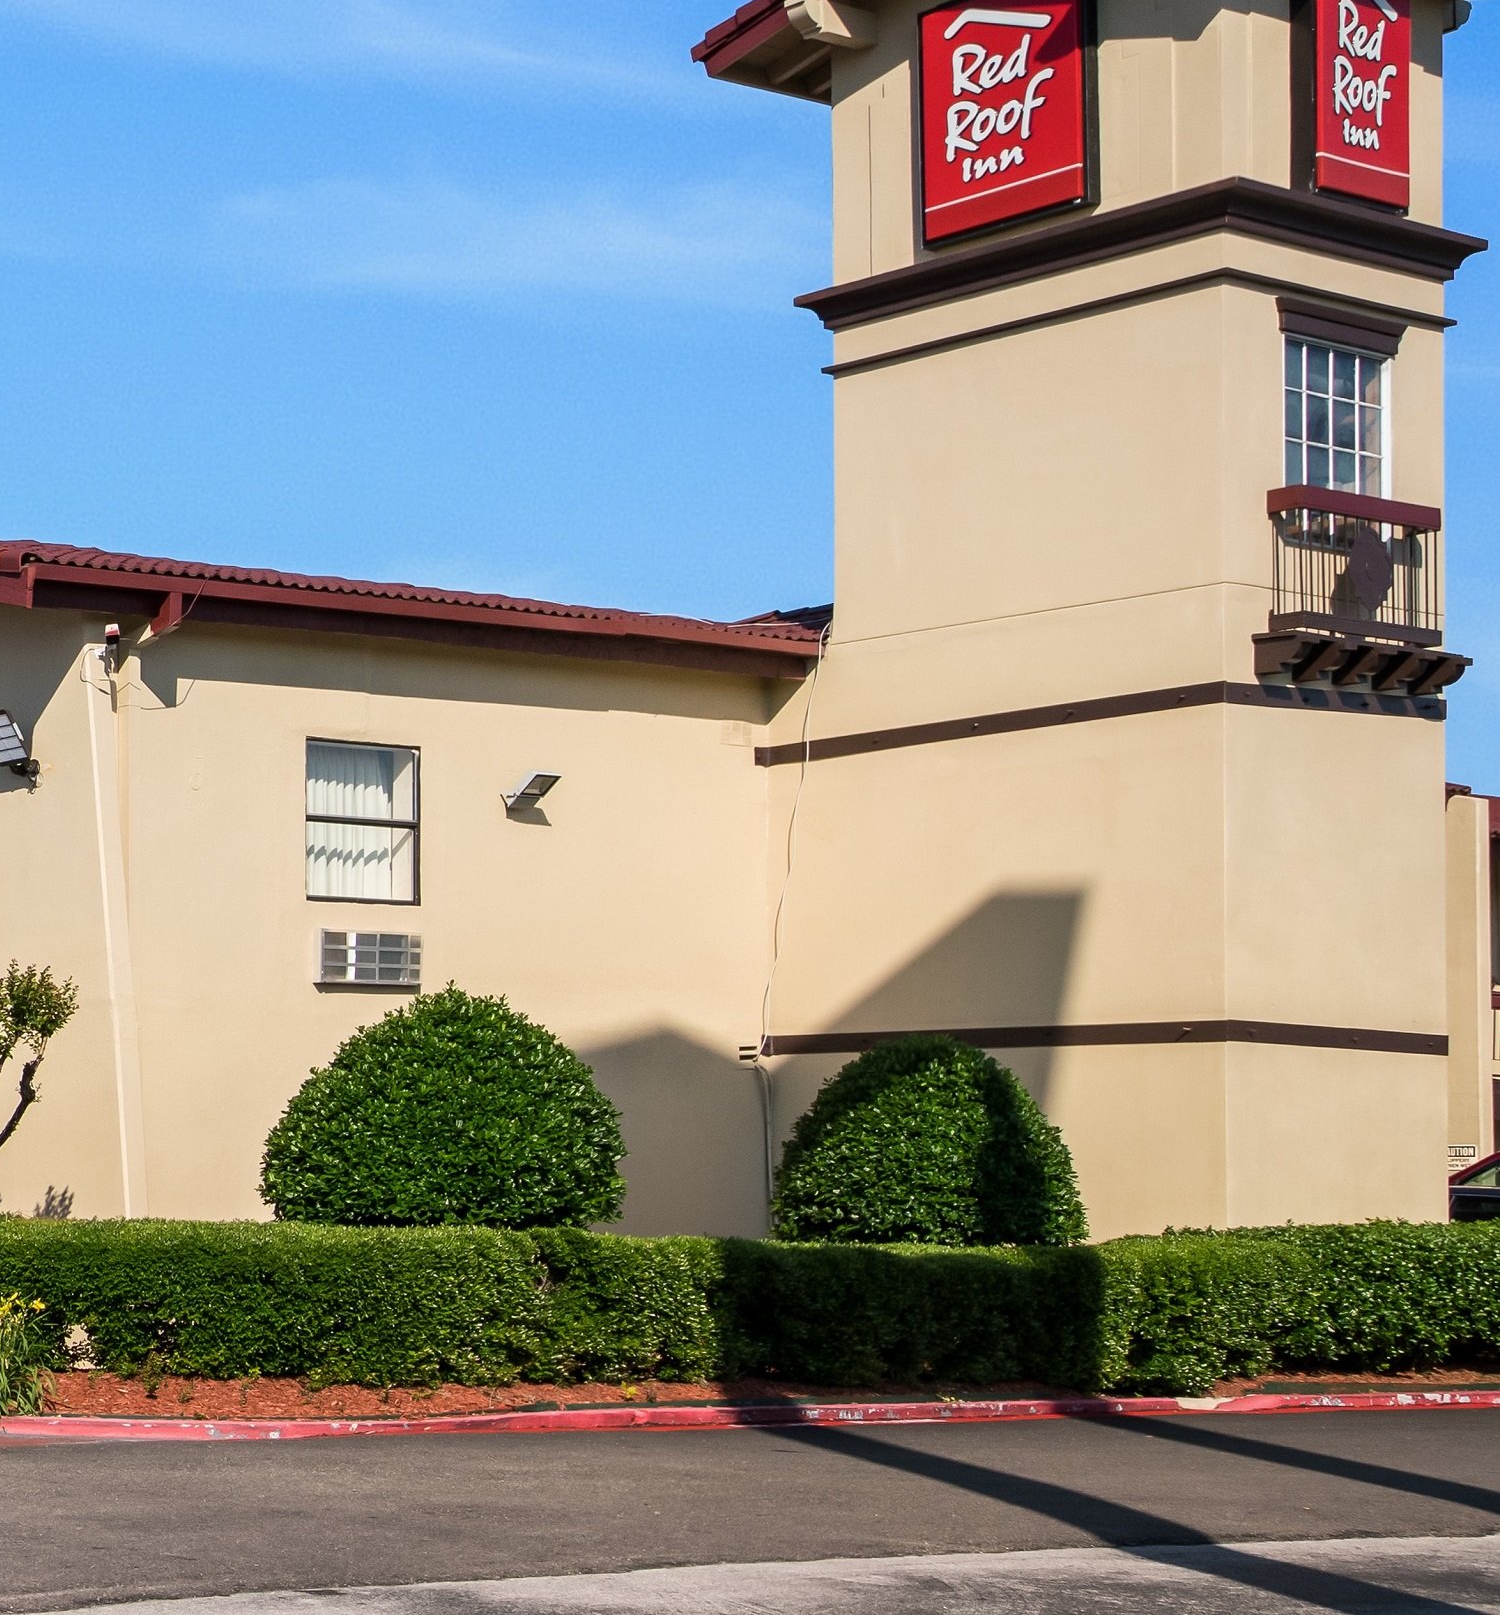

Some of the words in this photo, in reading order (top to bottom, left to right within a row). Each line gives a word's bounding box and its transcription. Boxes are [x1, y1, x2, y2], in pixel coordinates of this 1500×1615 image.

[952, 34, 1031, 96] Red
[1332, 55, 1397, 127] Roof
[944, 68, 1055, 162] Roof
